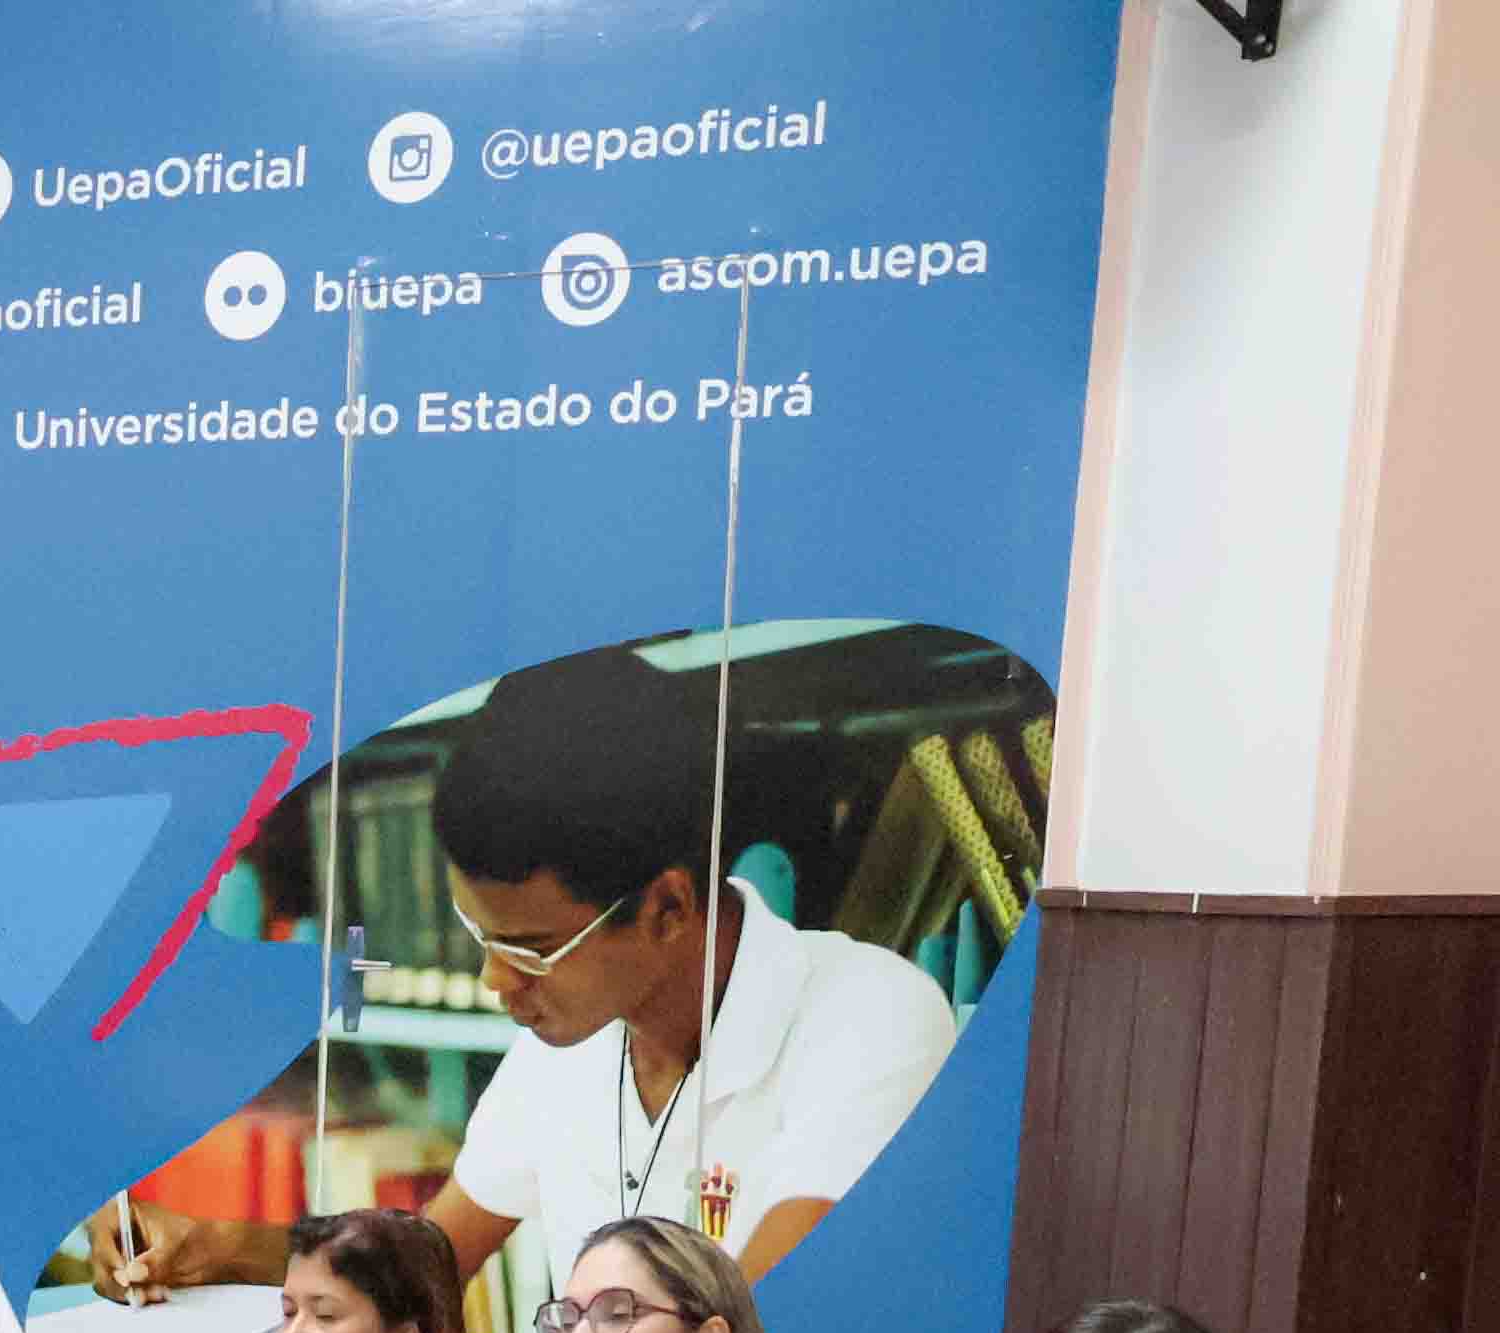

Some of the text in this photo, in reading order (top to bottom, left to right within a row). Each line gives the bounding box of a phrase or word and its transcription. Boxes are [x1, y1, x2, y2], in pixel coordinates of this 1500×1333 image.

[481, 100, 827, 180] @uepaoficial
[33, 144, 307, 211] UepaOficial
[313, 269, 483, 315] biuepa
[657, 239, 988, 293] ascom.uepa
[15, 372, 813, 450] Universidade do Estado do Pará
